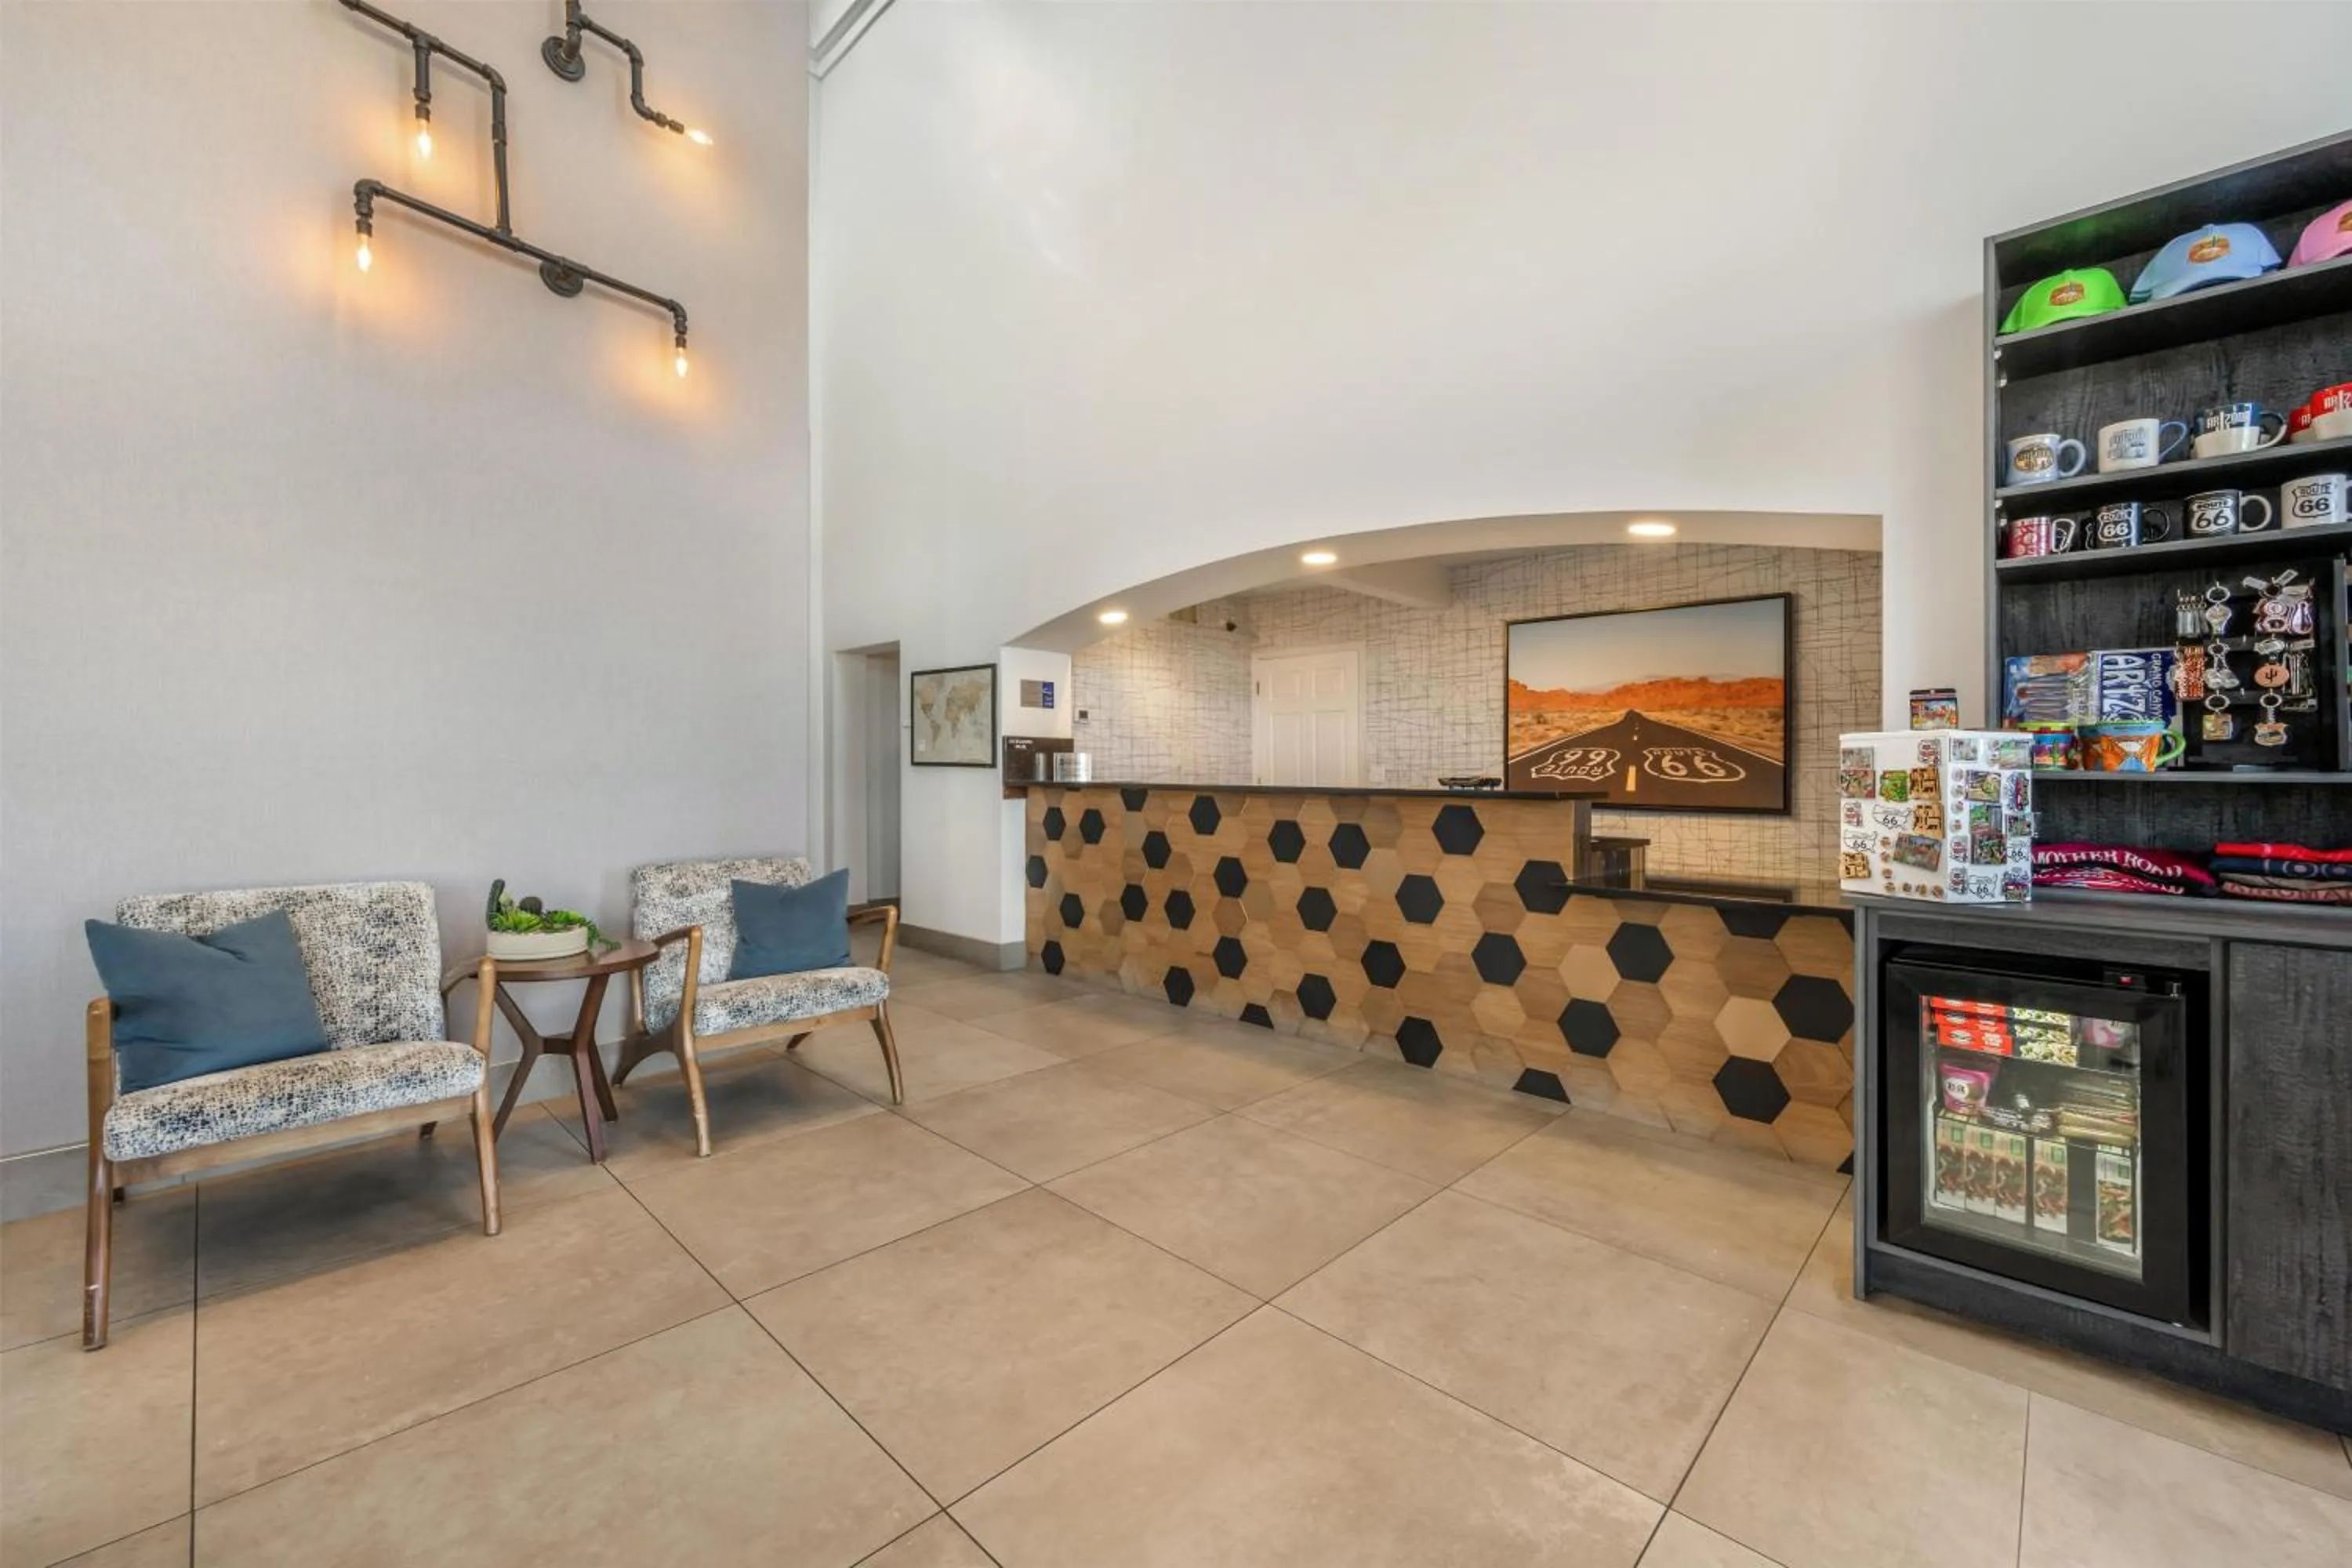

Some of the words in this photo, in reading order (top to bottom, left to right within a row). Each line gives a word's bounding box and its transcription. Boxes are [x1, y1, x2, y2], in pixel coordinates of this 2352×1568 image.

[2299, 483, 2332, 495] ROUTE
[2299, 498, 2329, 513] 66
[2196, 510, 2229, 528] 66
[2103, 522, 2129, 537] 66
[2151, 652, 2162, 687] GRAND
[1559, 750, 1607, 766] 66
[1661, 754, 1726, 777] 66
[1541, 764, 1603, 776] ROUTE
[1883, 815, 1898, 826] 66
